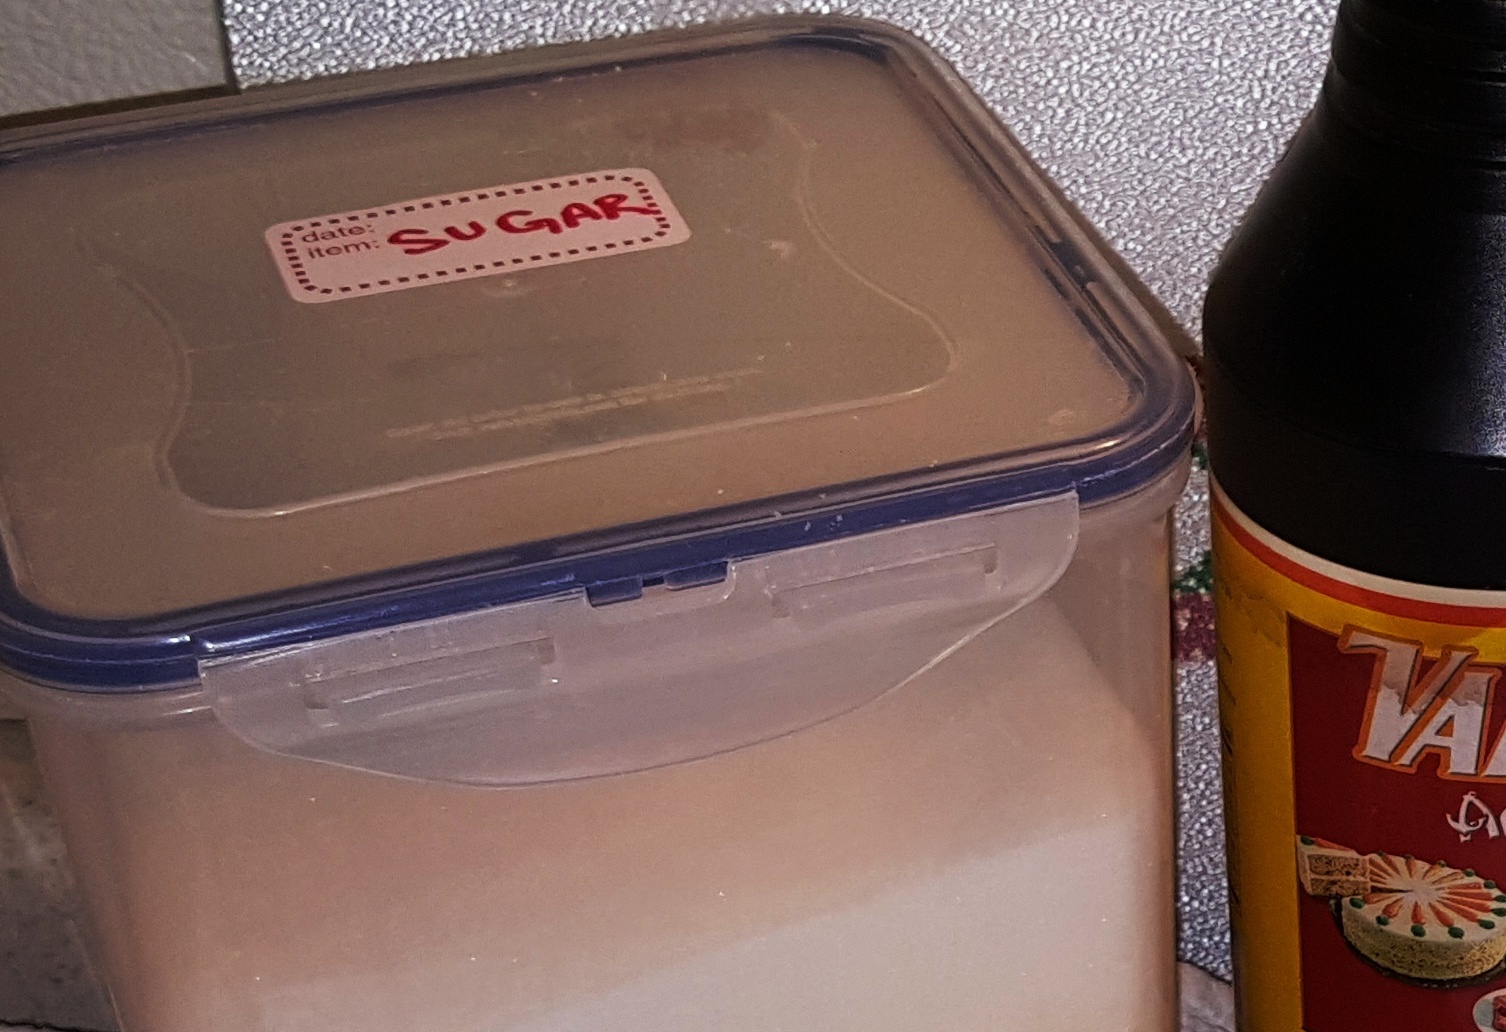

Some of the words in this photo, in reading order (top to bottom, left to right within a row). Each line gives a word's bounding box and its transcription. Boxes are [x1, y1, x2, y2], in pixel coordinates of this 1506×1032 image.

[302, 222, 375, 245] date:
[387, 192, 661, 255] SUGAR
[307, 239, 381, 261] item:
